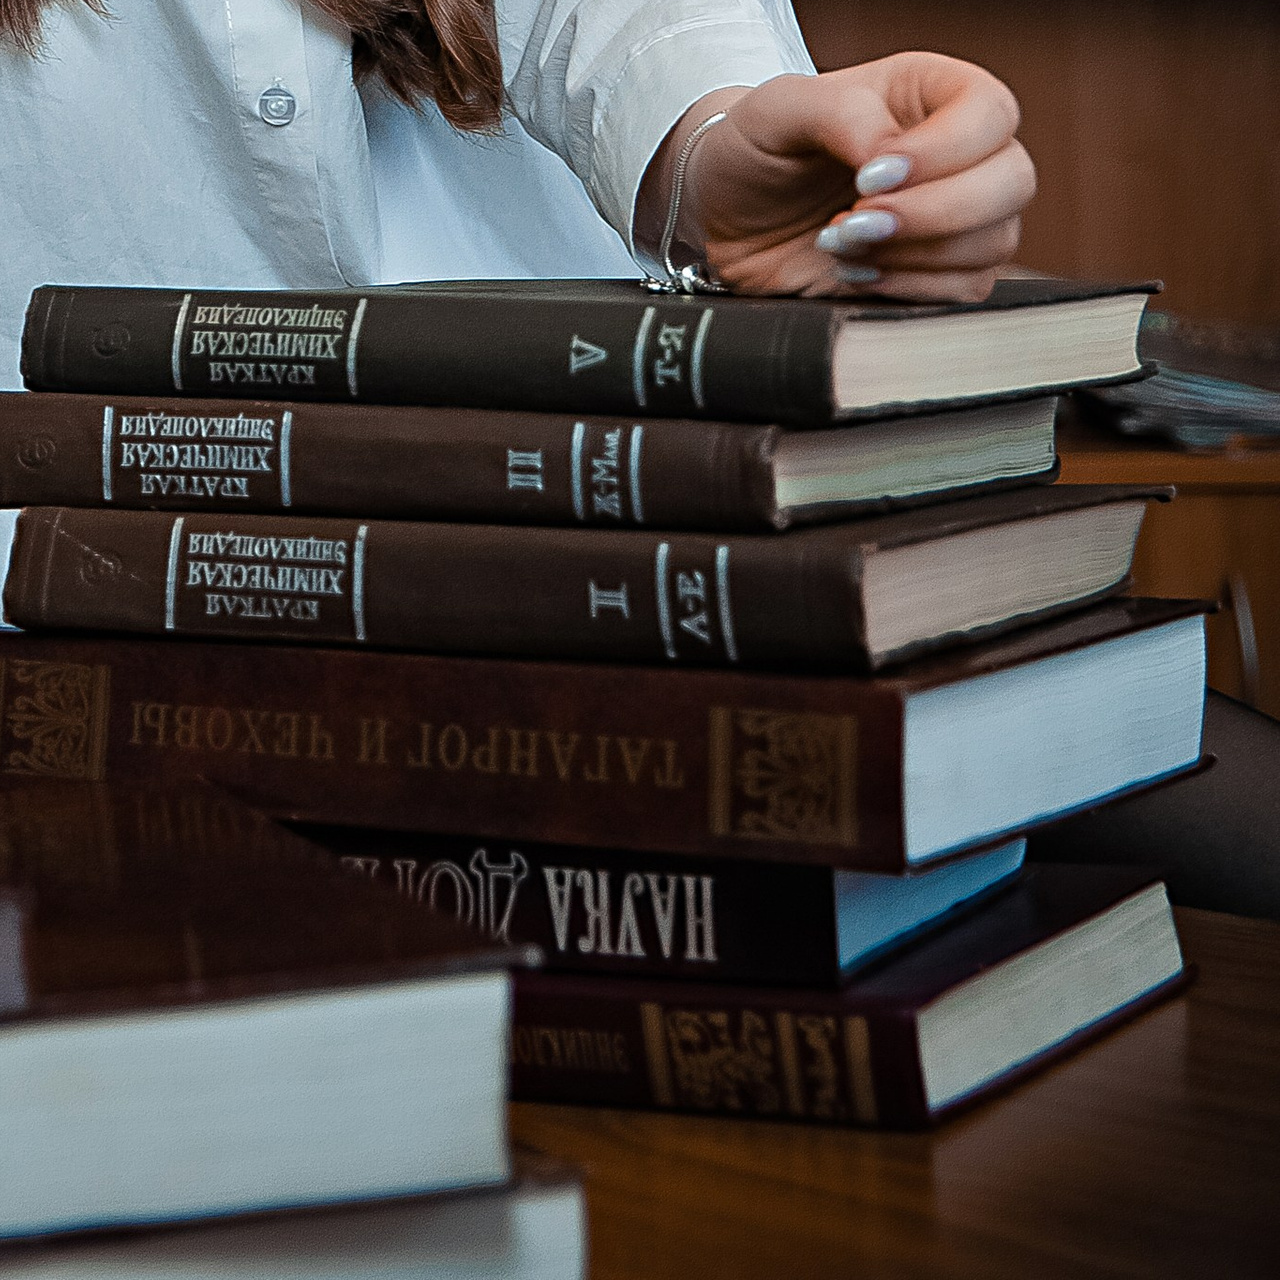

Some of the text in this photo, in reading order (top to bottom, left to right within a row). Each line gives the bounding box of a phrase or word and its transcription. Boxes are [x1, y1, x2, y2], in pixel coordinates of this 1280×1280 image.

[193, 302, 348, 331] ЭНЦИКЛОПЕДИЯ
[191, 330, 342, 359] ХИМИЧЕСКАЯ
[569, 335, 608, 372] V
[210, 361, 316, 385] КРАТКАЯ
[119, 414, 275, 441] ЭНЦИКЛОПЕДИЯ
[120, 442, 271, 473] ХИМИЧЕСКАЯ
[507, 449, 543, 491] II
[141, 475, 248, 497] КРАТКАЯ
[188, 532, 347, 562] ЭНЦИКЛОПЕДИЯ
[186, 562, 343, 594] ХИМИЧЕСКАЯ
[206, 595, 318, 619] КРАТКАЯ
[130, 702, 684, 787] ТАГАНРОГ И ЧЕХОВЫ
[542, 867, 716, 962] НАУКА
